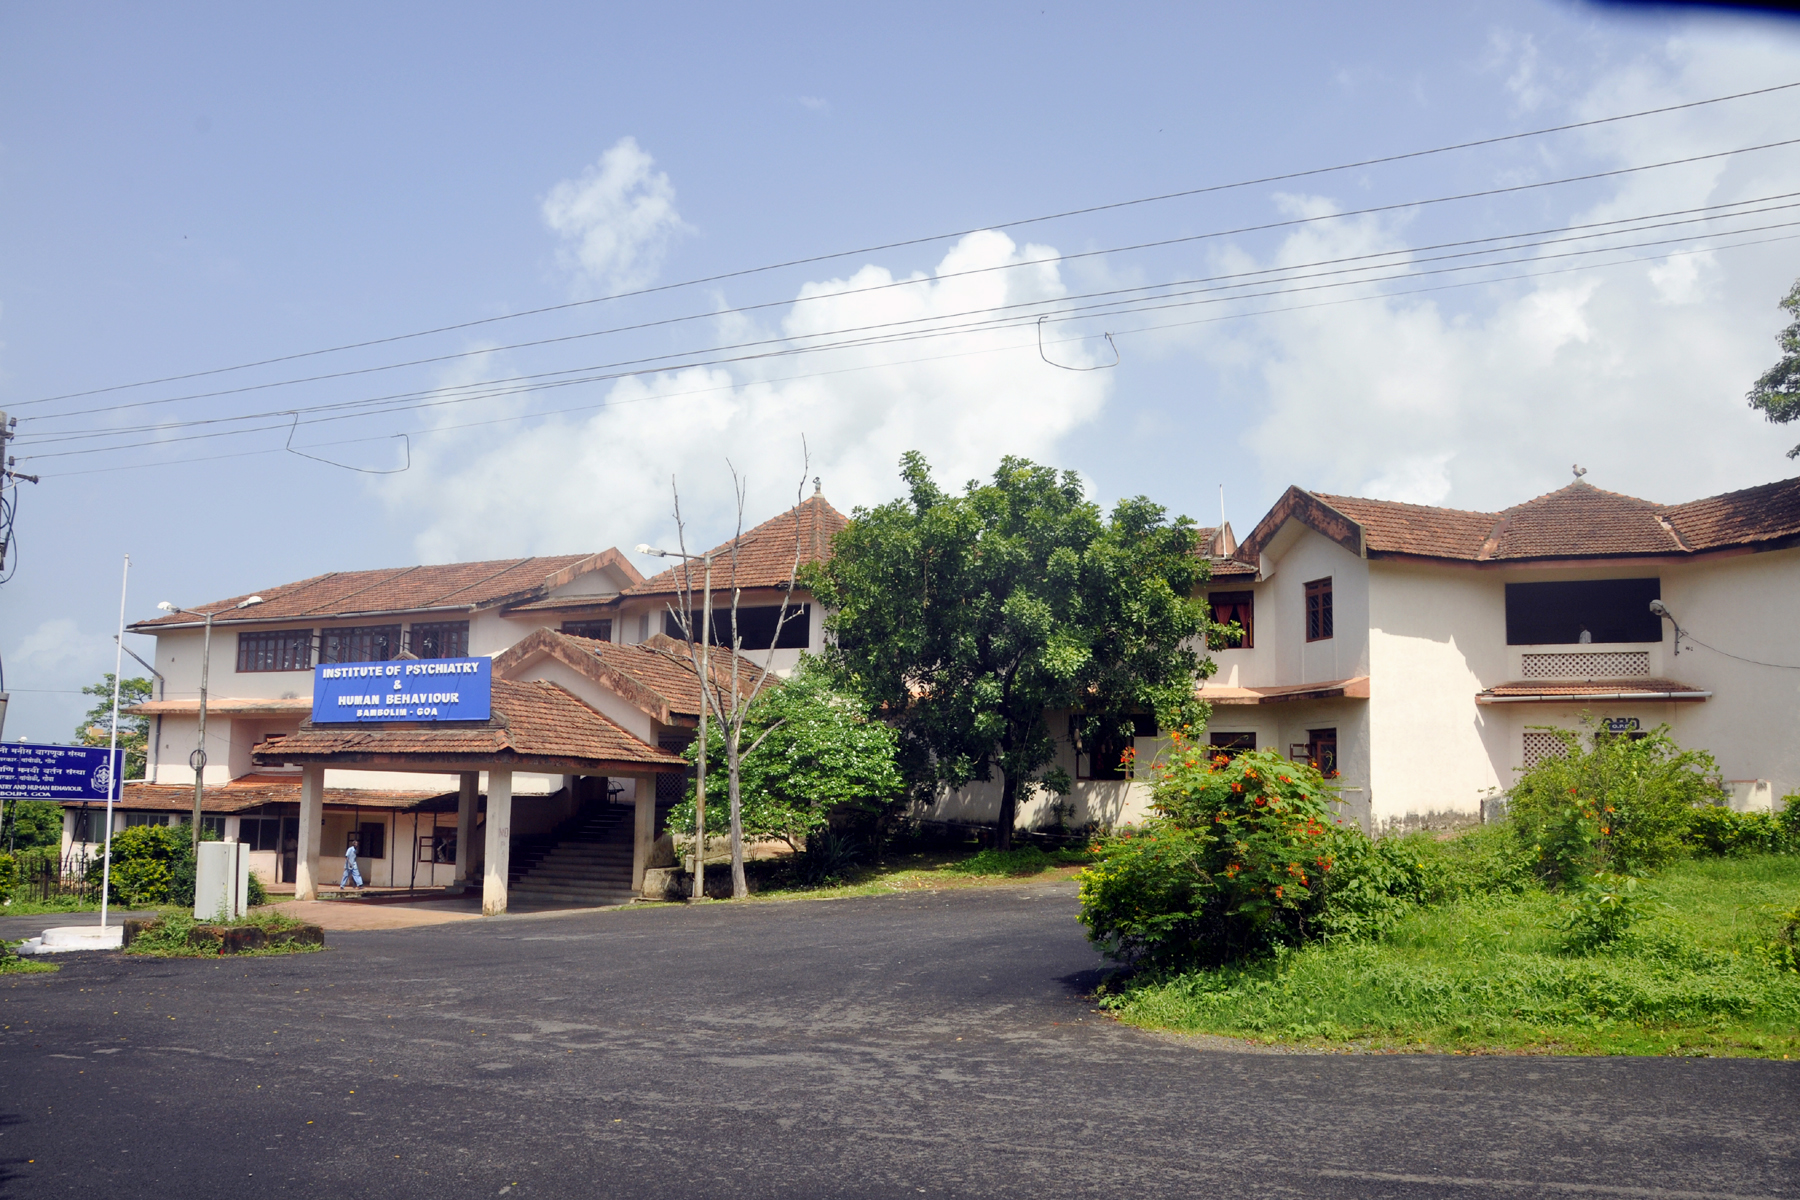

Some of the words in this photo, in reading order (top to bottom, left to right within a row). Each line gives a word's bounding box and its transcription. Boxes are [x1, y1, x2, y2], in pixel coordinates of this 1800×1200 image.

[322, 666, 383, 679] INSTITUTE
[385, 665, 401, 676] OF
[405, 662, 480, 676] PSYCHIATRY
[393, 679, 402, 690] &
[338, 694, 380, 706] HUMAN
[385, 692, 459, 705] BEHAVIOUR
[356, 708, 407, 717] BAMBOLIM
[416, 707, 438, 716] GOA
